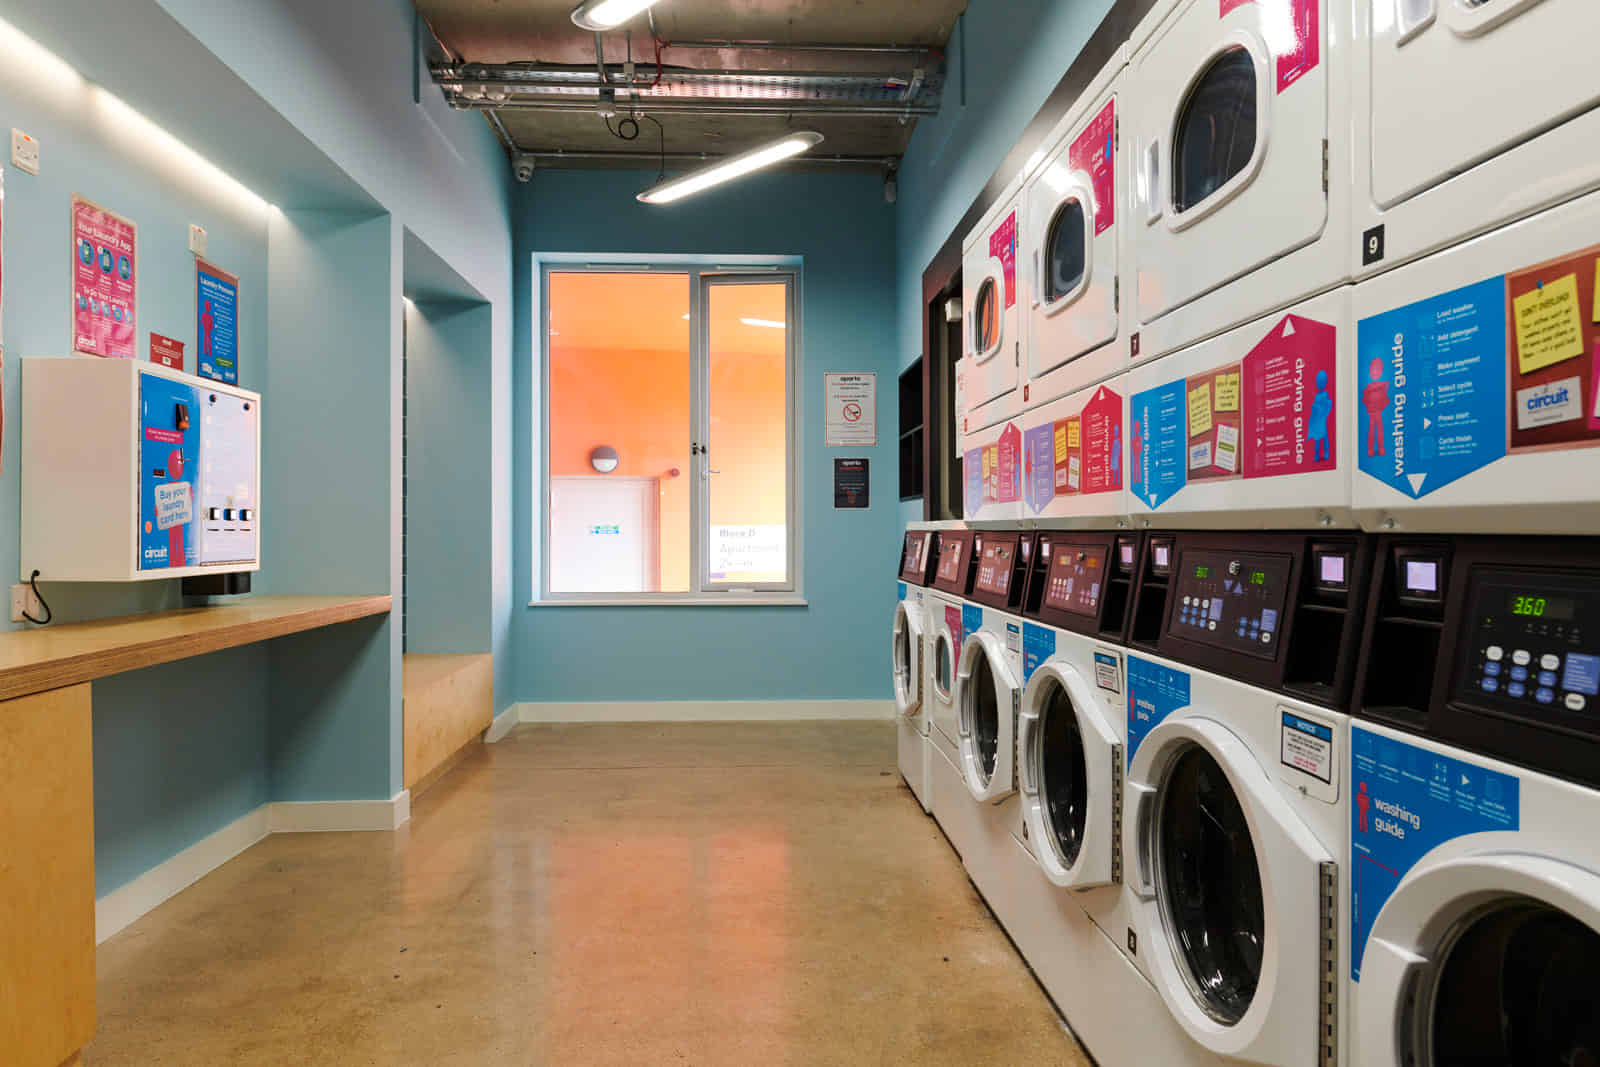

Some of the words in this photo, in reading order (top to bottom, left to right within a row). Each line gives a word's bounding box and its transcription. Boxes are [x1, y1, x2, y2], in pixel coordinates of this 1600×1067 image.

[1369, 235, 1378, 255] 9
[1449, 325, 1479, 339] detergent
[1391, 333, 1407, 388] guide
[1454, 355, 1481, 369] payment
[1294, 358, 1305, 413] drying
[1438, 383, 1456, 393] Select
[1456, 381, 1473, 391] cycle
[1527, 387, 1569, 411] circuit
[1294, 416, 1305, 465] guide
[1391, 393, 1407, 477] washing
[159, 487, 172, 501] Buy
[172, 487, 186, 500] your
[162, 499, 185, 514] laundry
[159, 512, 174, 525] card
[175, 510, 188, 521] here
[144, 545, 168, 559] circuit
[1374, 798, 1421, 831] washing
[1375, 817, 1405, 840] guide
